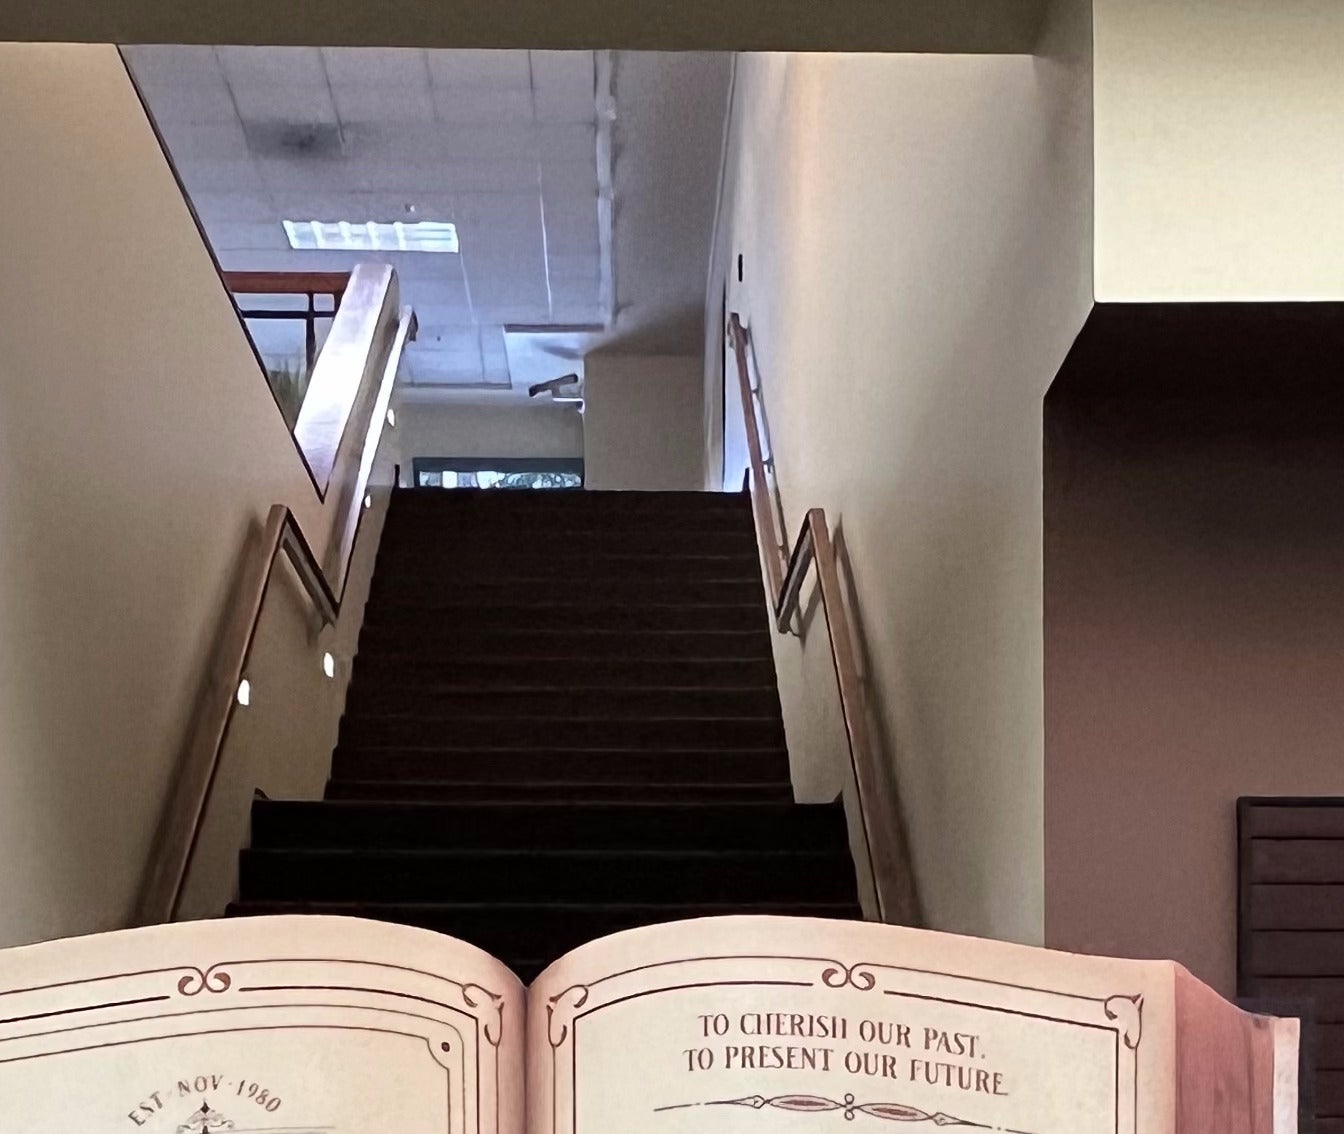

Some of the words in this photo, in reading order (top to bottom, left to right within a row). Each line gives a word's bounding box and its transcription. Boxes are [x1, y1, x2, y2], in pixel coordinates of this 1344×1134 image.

[699, 1013, 729, 1037] TO
[739, 1013, 847, 1040] CHERISH
[859, 1020, 911, 1048] OUR
[684, 1048, 714, 1071] TO
[724, 1046, 834, 1071] PRESENT
[844, 1052, 896, 1080] OUR
[177, 1075, 223, 1097] NOV
[237, 1080, 282, 1112] 1980
